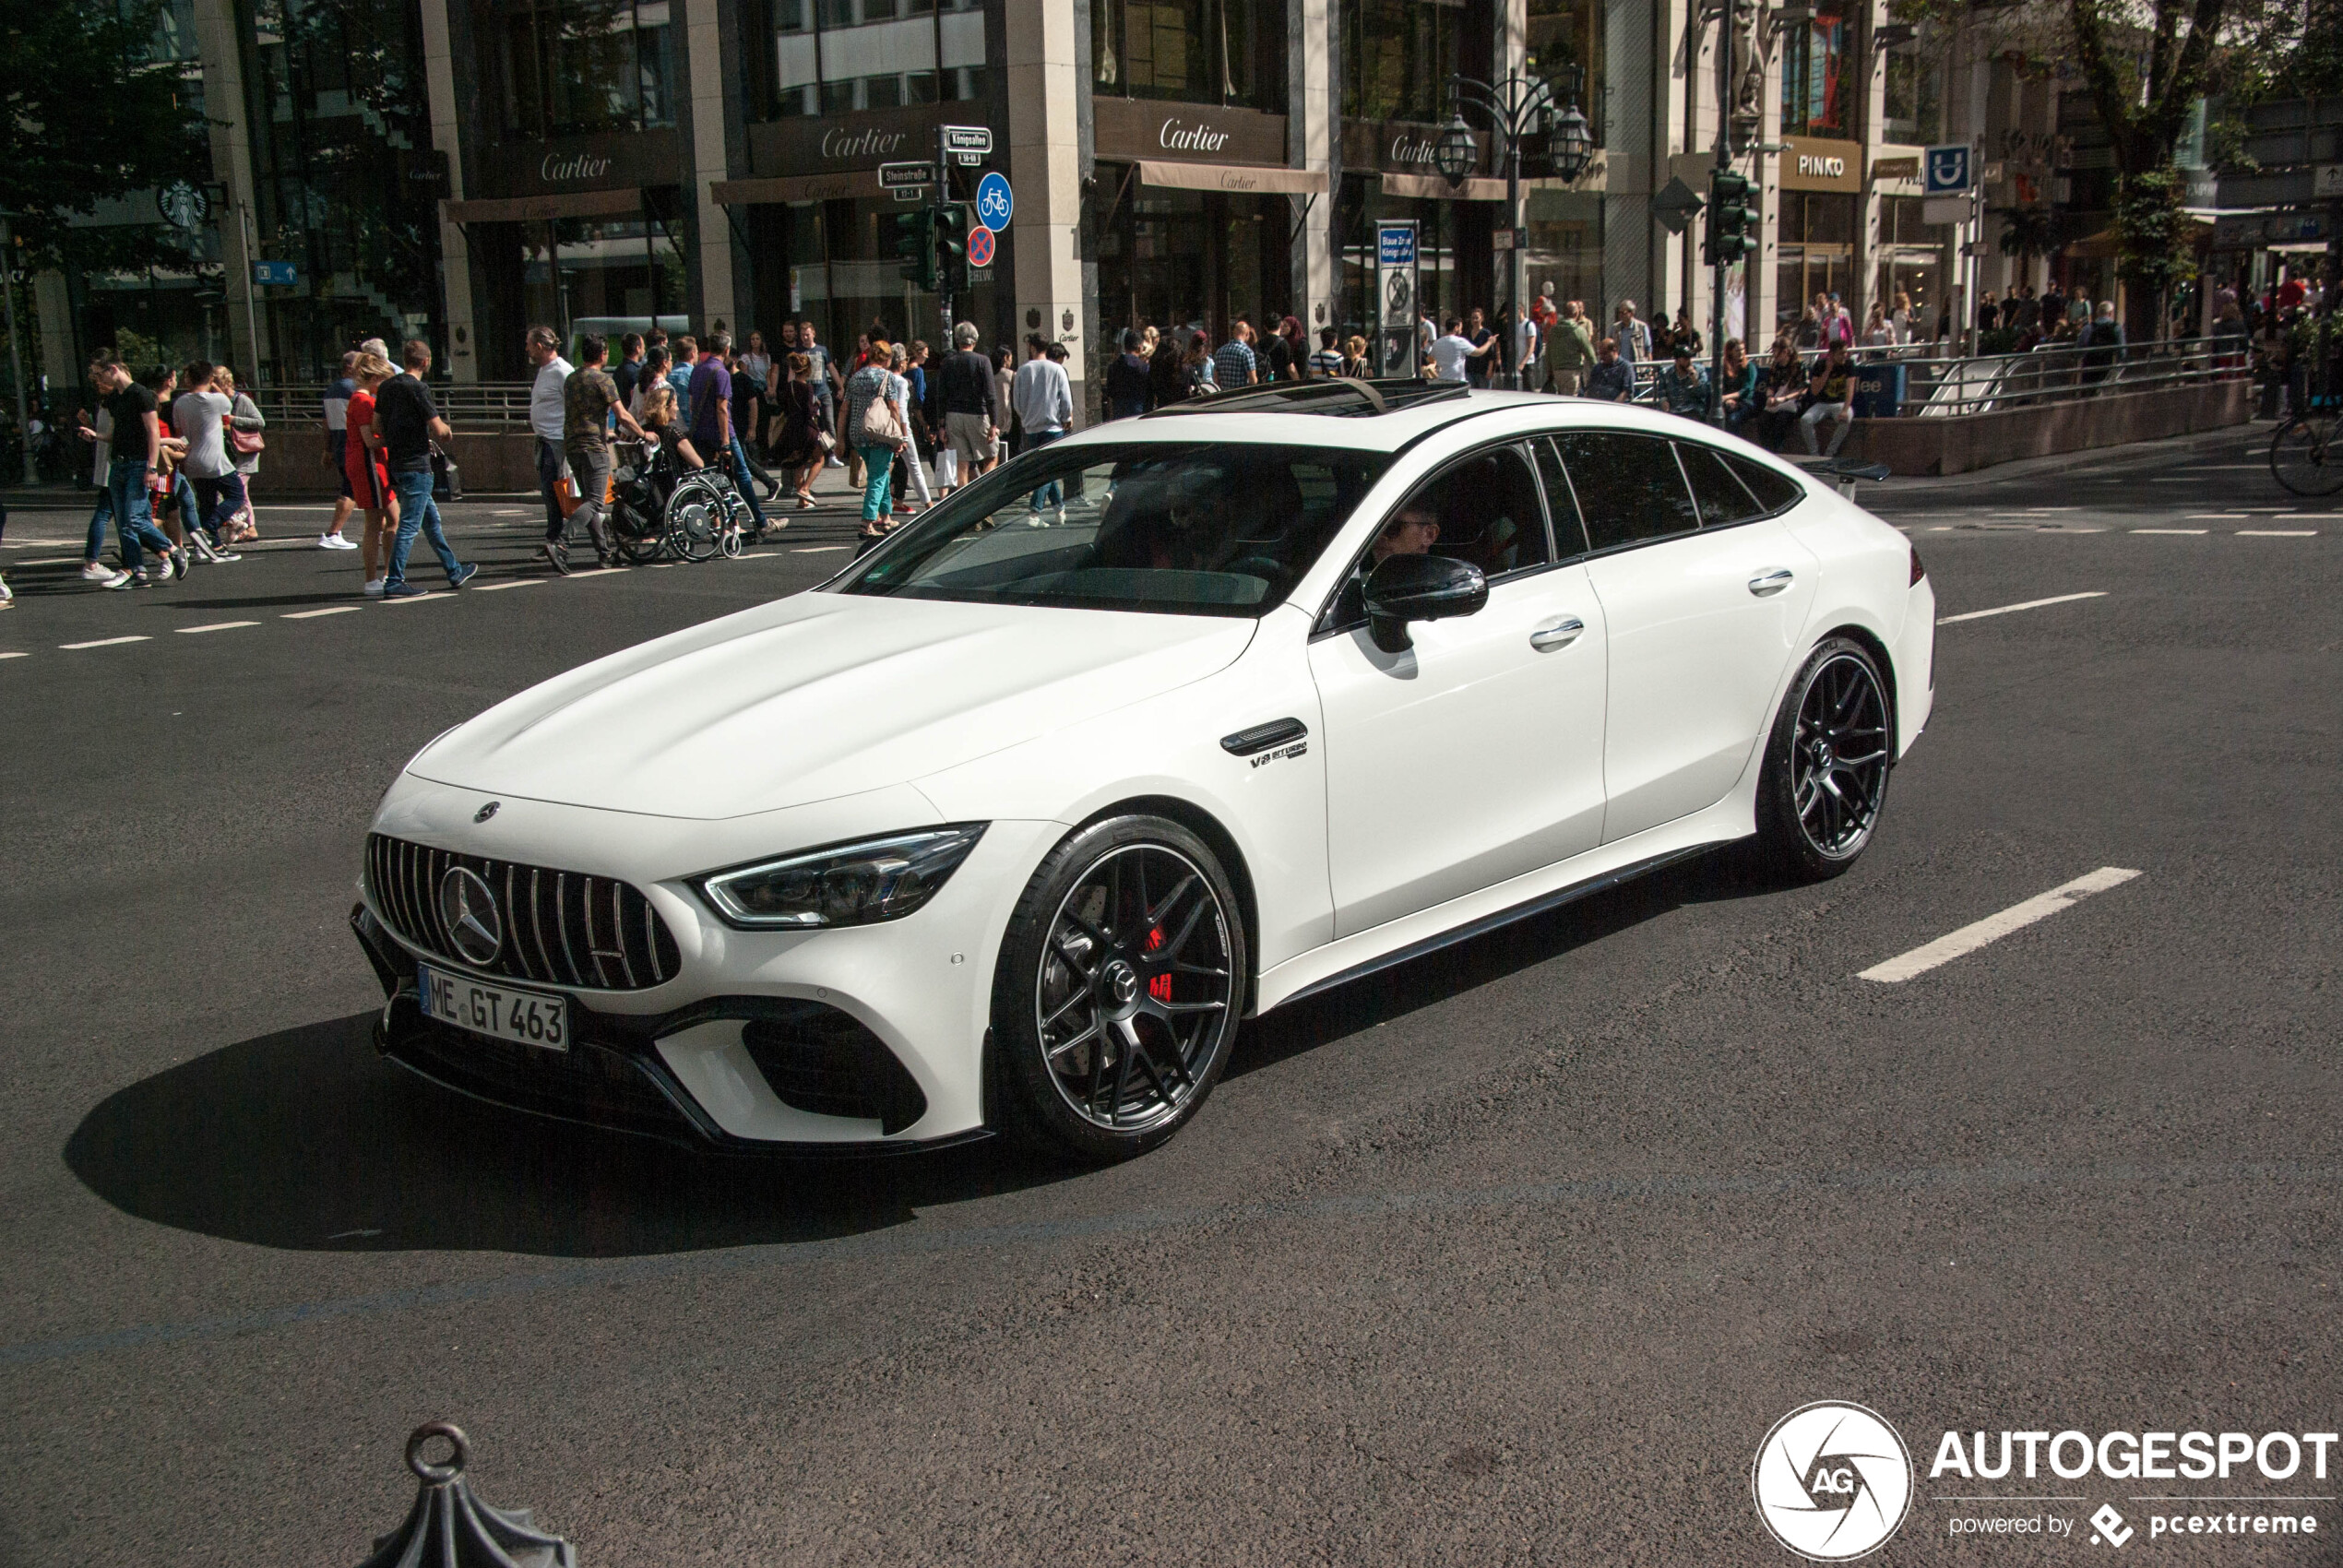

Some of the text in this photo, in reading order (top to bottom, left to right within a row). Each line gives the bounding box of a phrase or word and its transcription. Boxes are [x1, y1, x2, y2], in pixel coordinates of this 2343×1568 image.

[822, 127, 906, 158] Cartier
[952, 133, 986, 148] Königsallee
[1160, 117, 1229, 151] Cartier
[1391, 134, 1437, 164] Cartie
[541, 152, 612, 182] Cartier
[886, 169, 927, 182] Steinstraße
[1799, 154, 1844, 178] PINKO
[1220, 170, 1256, 190] Cartier
[1382, 236, 1397, 246] Blaue
[1059, 333, 1079, 343] Cartier
[1250, 754, 1271, 768] V8
[430, 974, 564, 1044] ME GT 463
